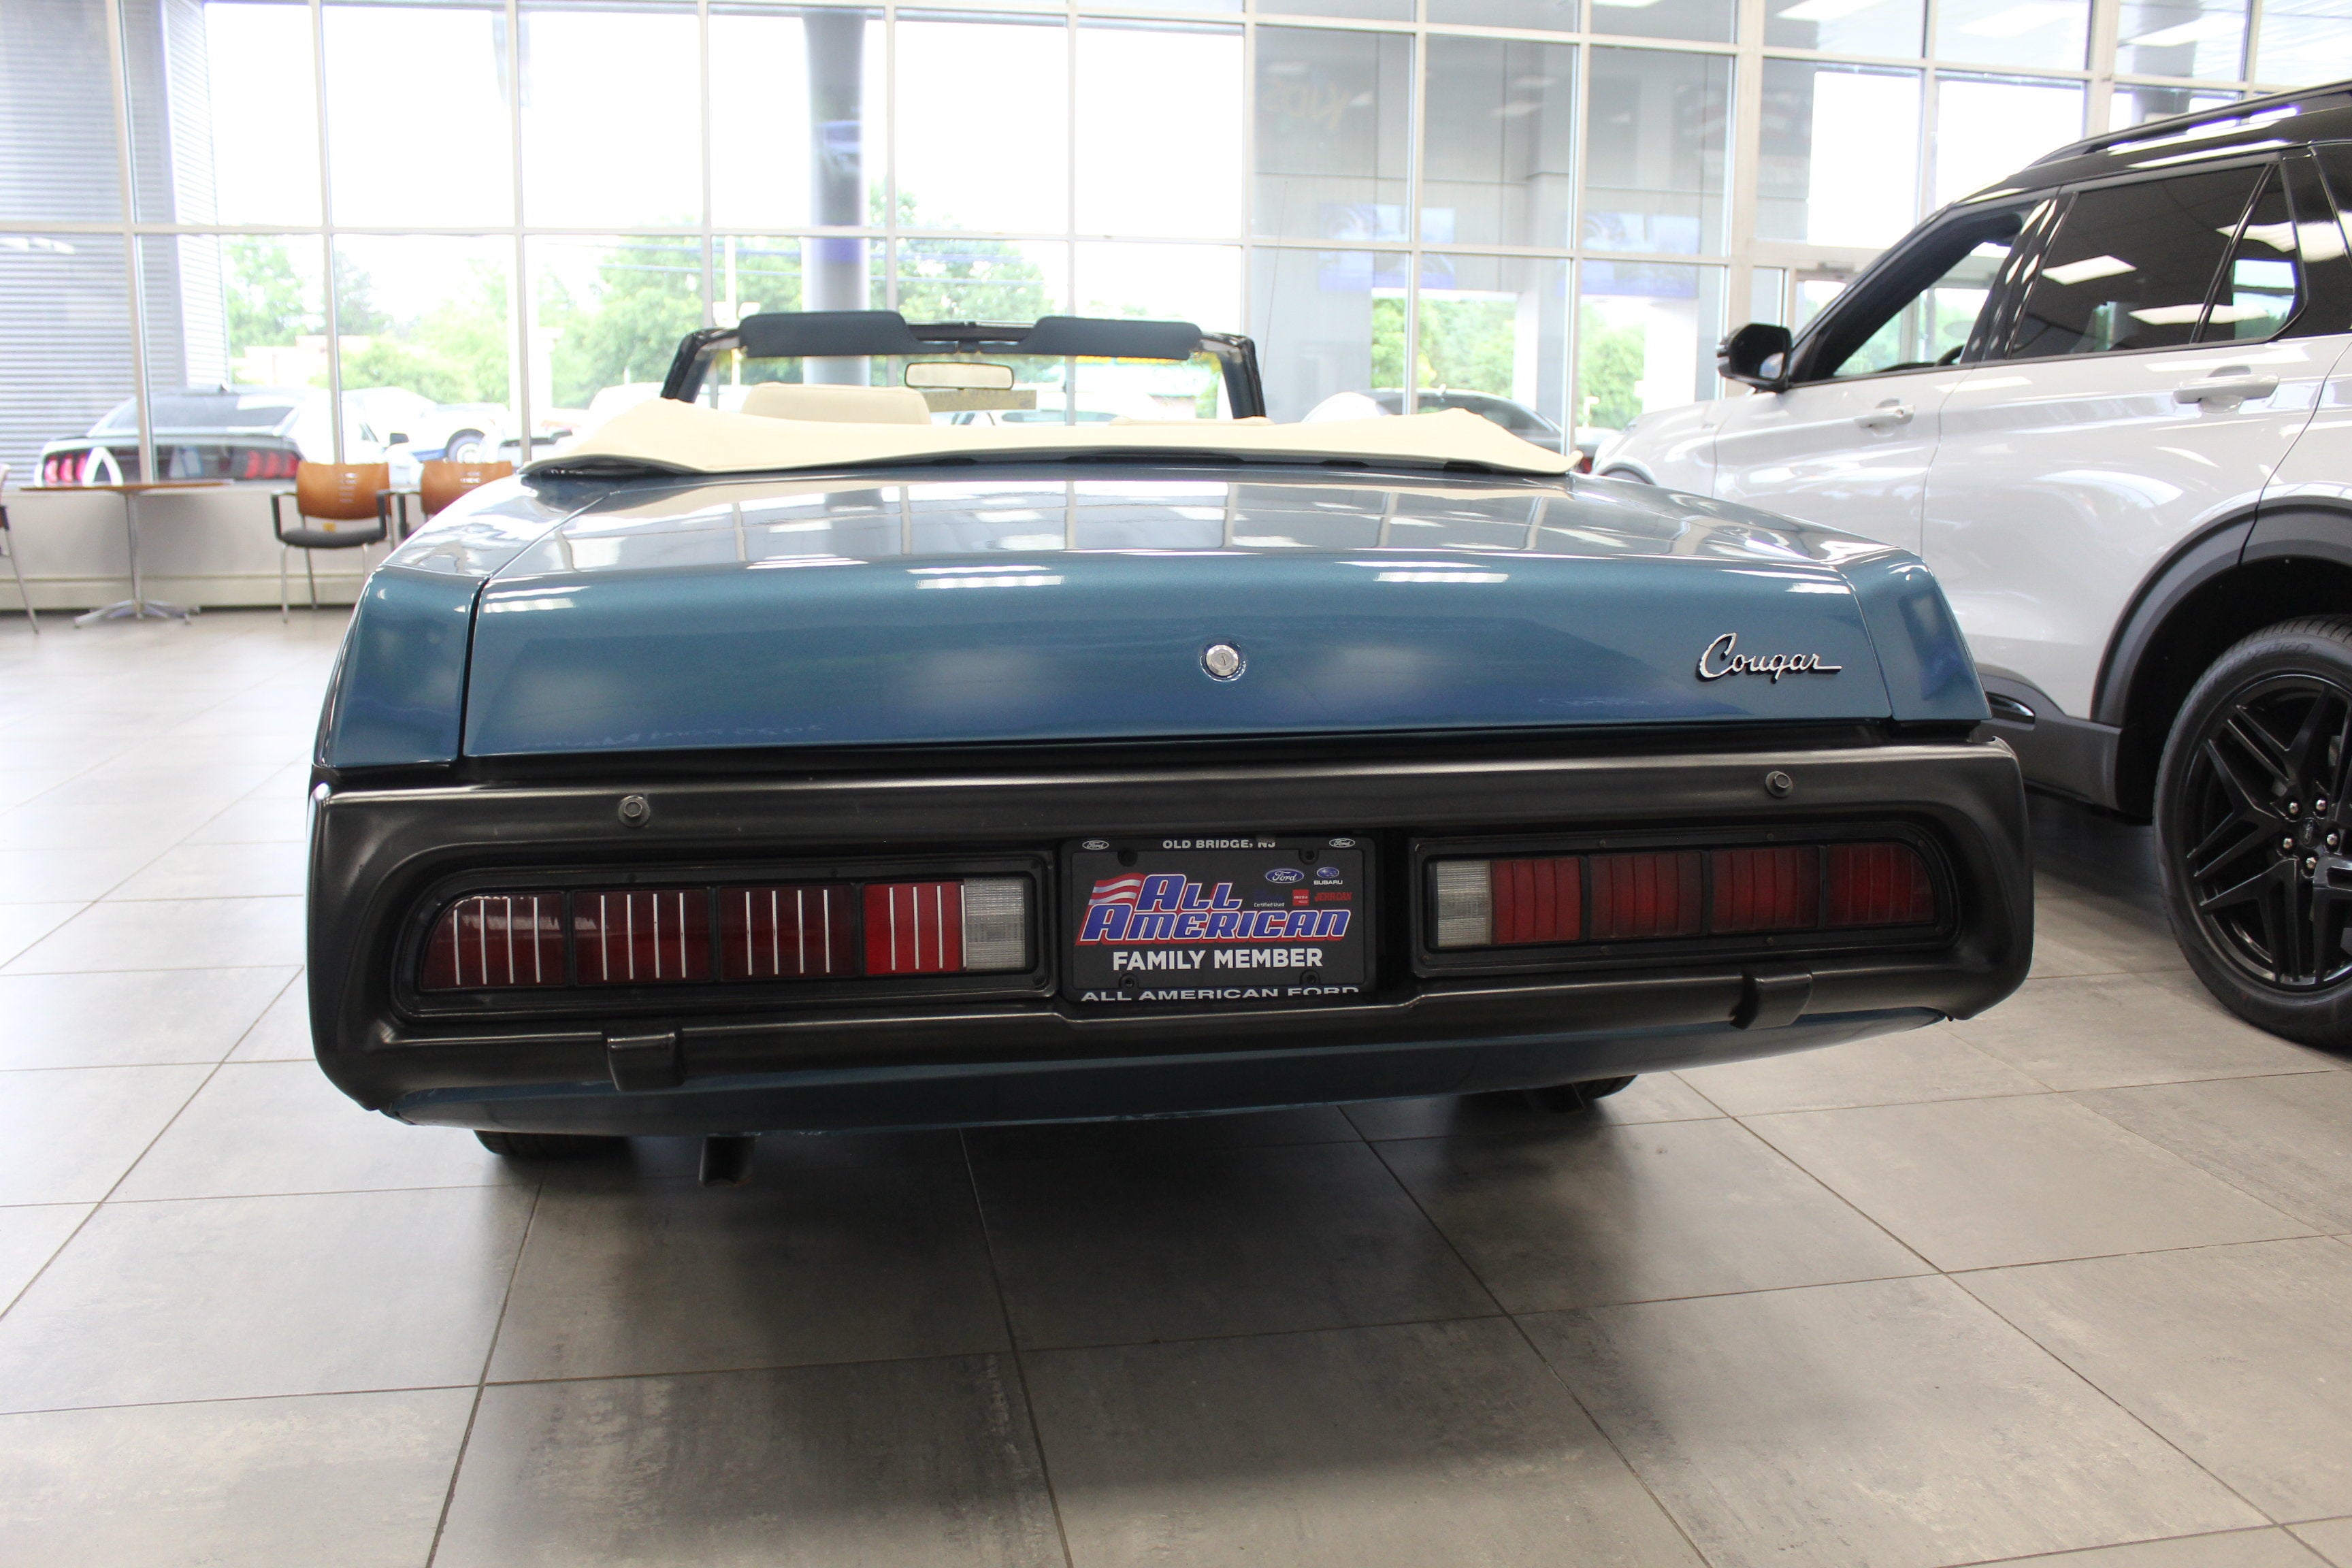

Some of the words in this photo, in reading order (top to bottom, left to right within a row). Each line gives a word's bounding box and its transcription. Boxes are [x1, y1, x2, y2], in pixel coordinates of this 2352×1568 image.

[1699, 632, 1842, 680] Cougar
[1162, 840, 1191, 849] OLD
[1196, 839, 1254, 848] BRIDGE,
[1271, 870, 1297, 881] Ford
[1113, 950, 1206, 971] FAMILY
[1213, 948, 1323, 969] MEMBER
[1081, 992, 1132, 1001] ALL
[1139, 989, 1278, 1000] AMERICAN
[1288, 987, 1359, 996] FORD
